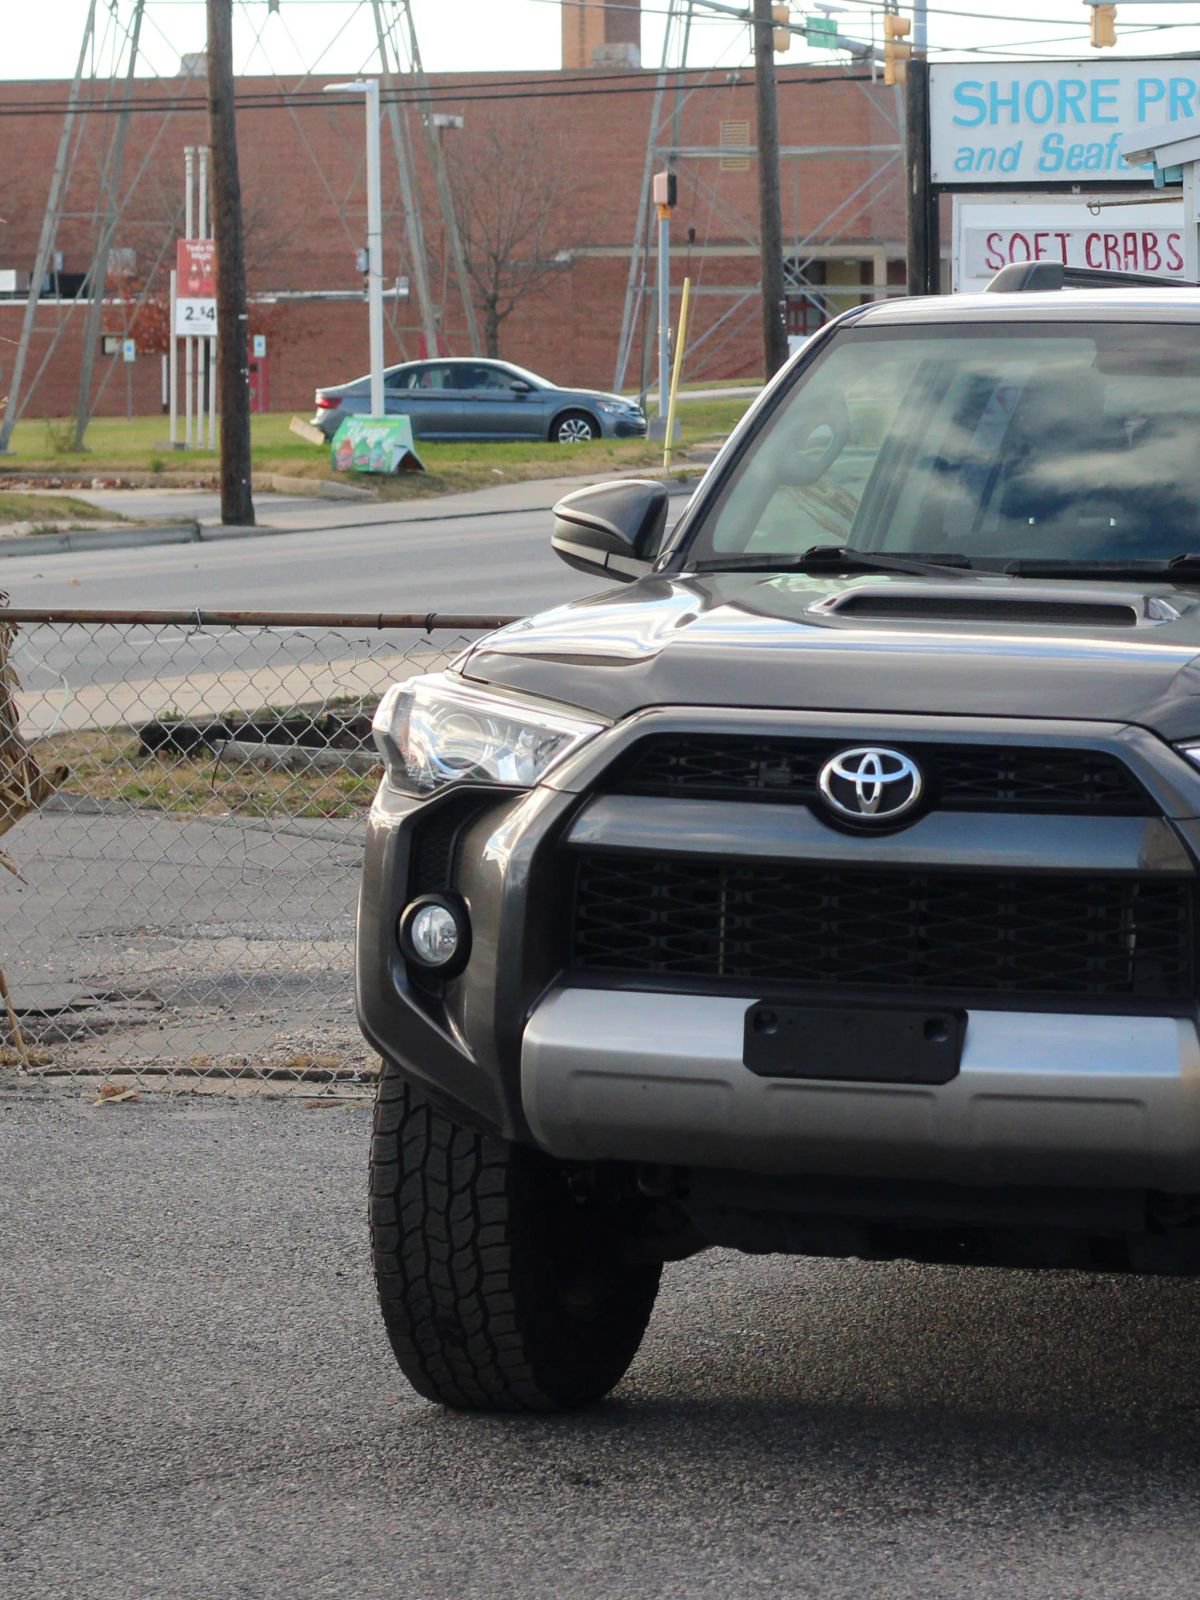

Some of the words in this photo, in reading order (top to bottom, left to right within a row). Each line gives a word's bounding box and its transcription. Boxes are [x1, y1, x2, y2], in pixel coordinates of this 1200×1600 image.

[952, 79, 1120, 127] SHORE
[954, 140, 1024, 172] and
[1038, 132, 1155, 172] Seaf
[985, 232, 1071, 271] SOFT
[1085, 232, 1184, 271] CRABS
